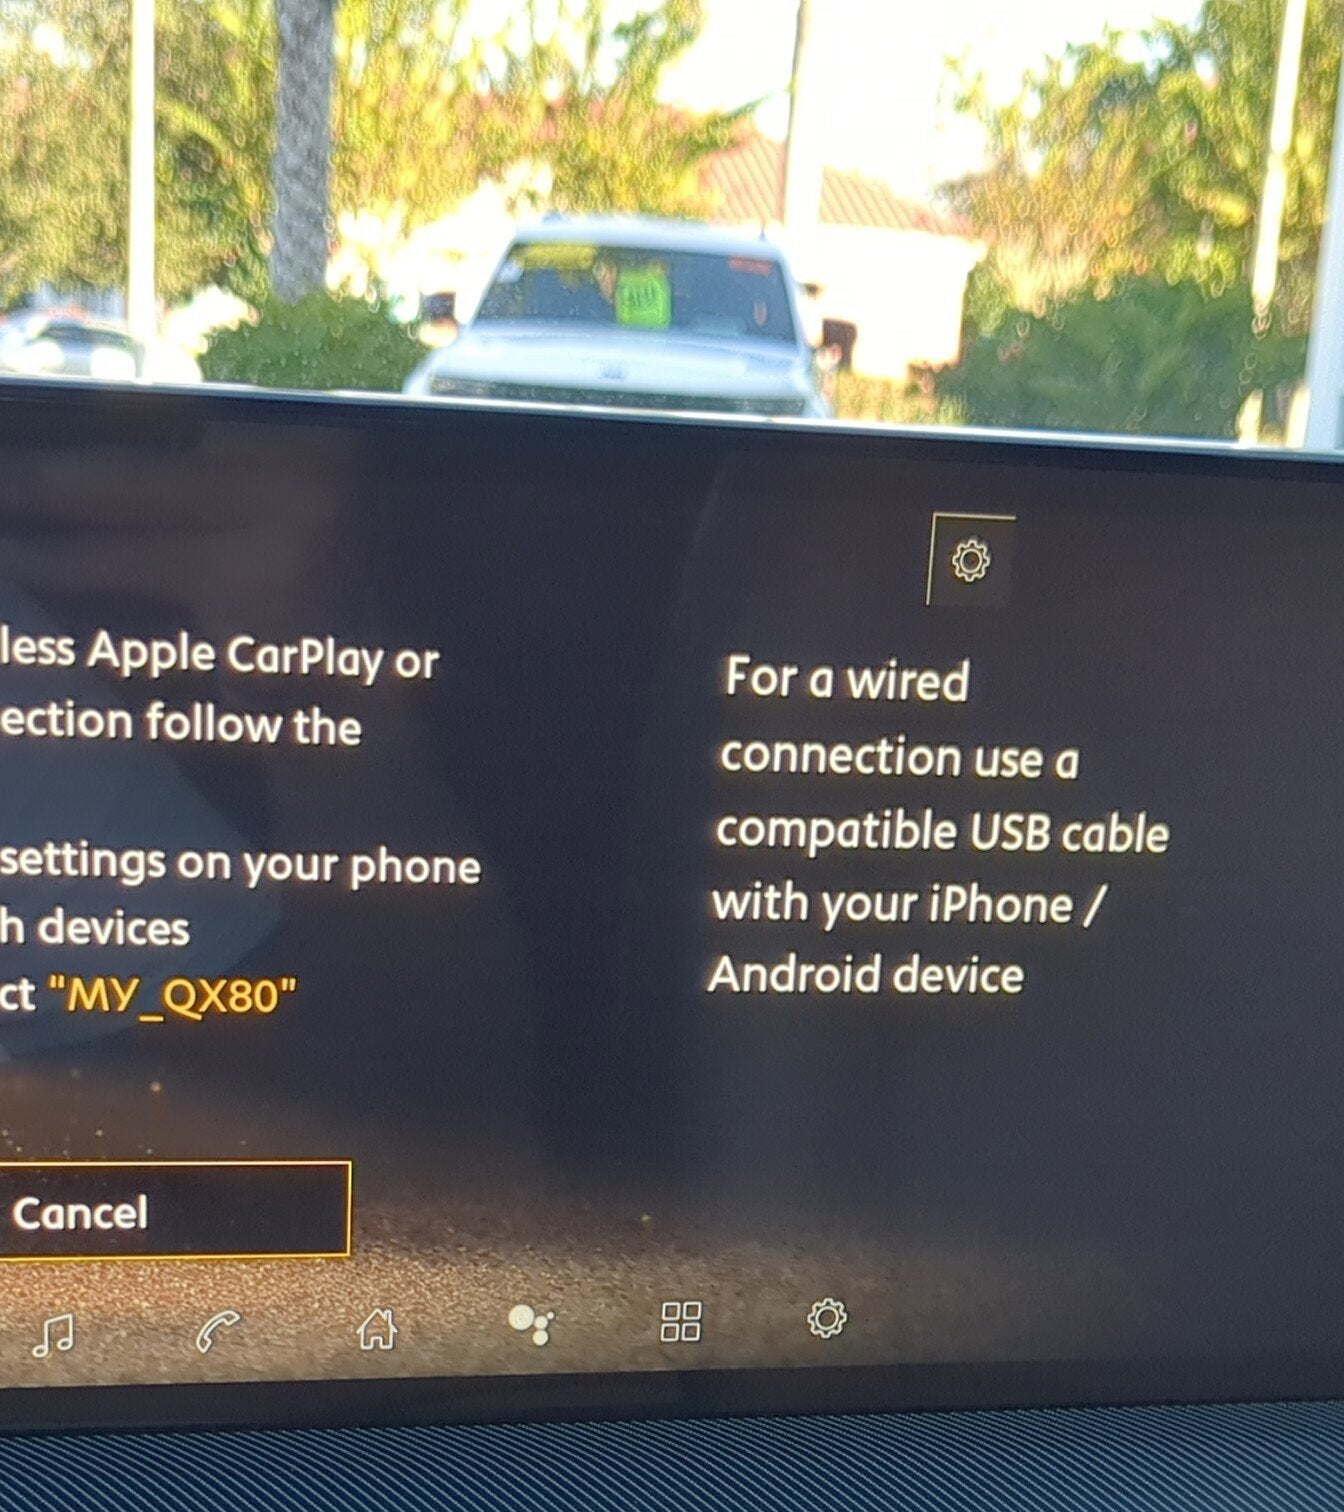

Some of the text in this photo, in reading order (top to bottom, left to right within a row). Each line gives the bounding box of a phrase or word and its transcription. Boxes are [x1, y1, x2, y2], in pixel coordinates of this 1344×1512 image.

[86, 629, 217, 679] Apple
[226, 634, 385, 687] CarPlay
[394, 649, 441, 680] or
[726, 654, 971, 703] For a wired
[144, 700, 285, 744] follow
[292, 705, 363, 747] the
[720, 734, 1080, 780] connection use a
[715, 807, 1170, 859] compatible USB cable
[176, 850, 232, 880] on
[242, 851, 340, 890] your
[350, 844, 482, 892] phone
[36, 906, 191, 947] devices
[711, 878, 809, 921] with
[820, 891, 920, 933] your
[929, 881, 1074, 924] iPhone
[706, 951, 1025, 994] Android device
[48, 973, 297, 1023] "MY_QX80"
[11, 1193, 148, 1231] Cancel
